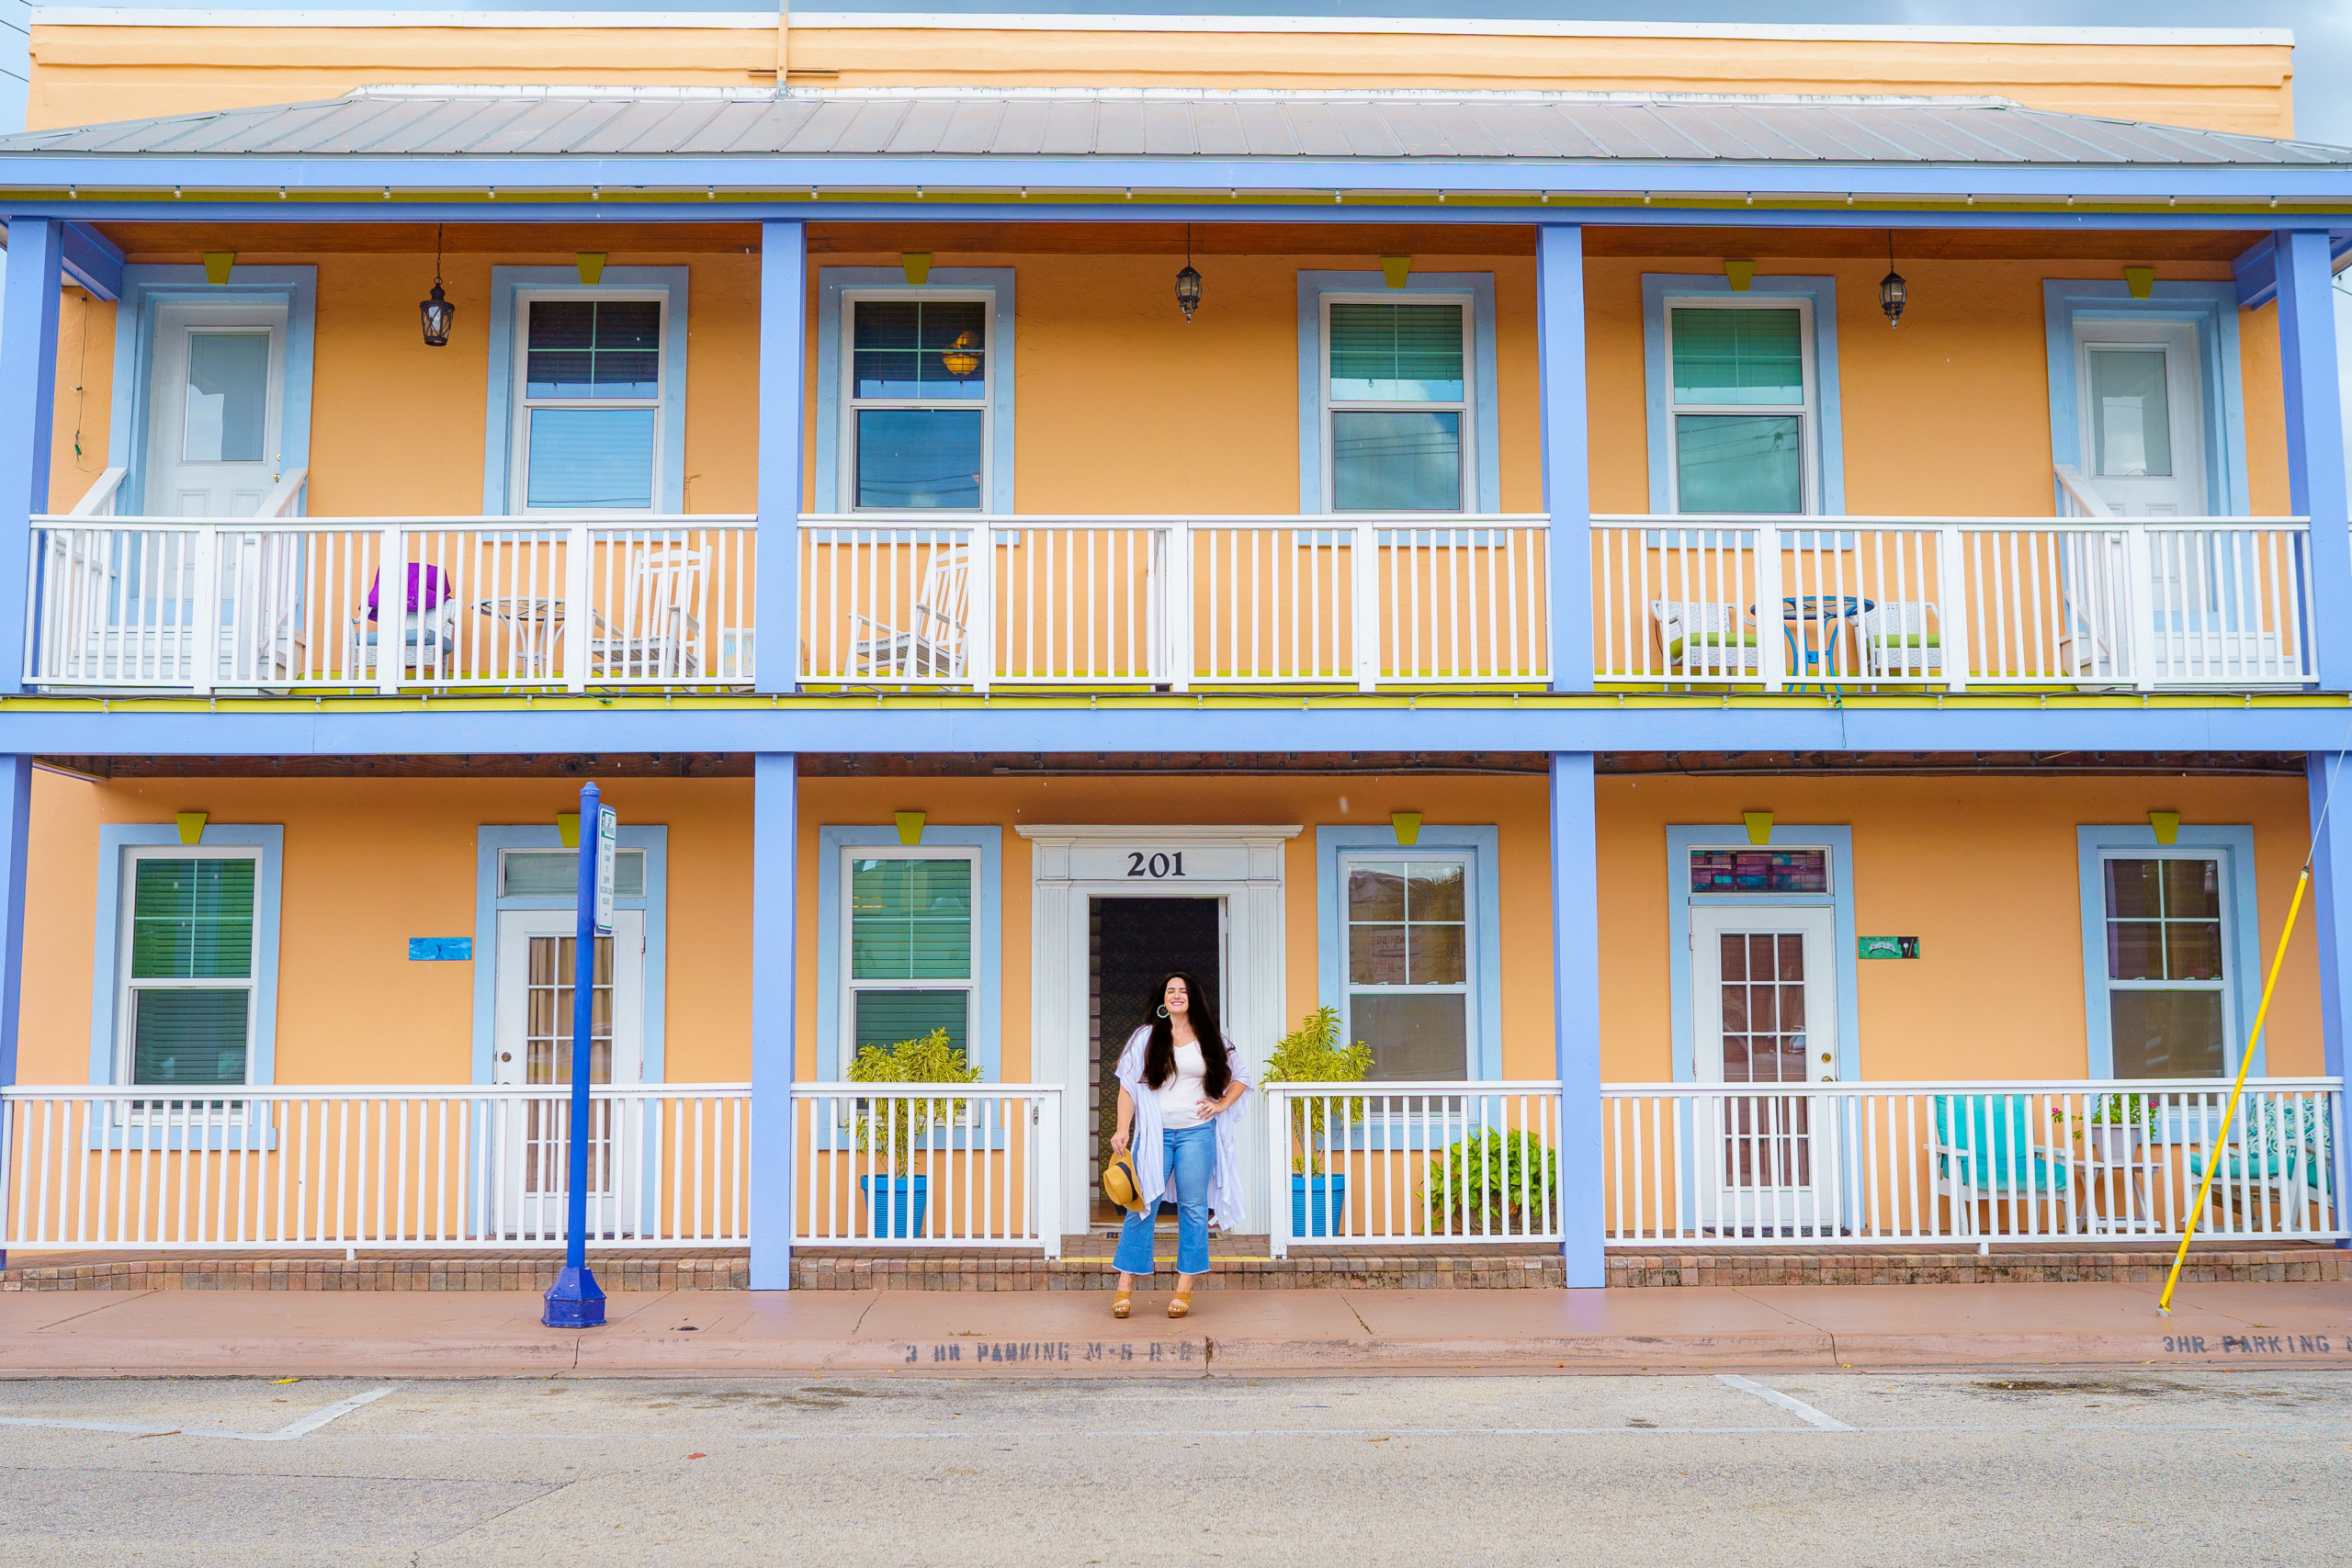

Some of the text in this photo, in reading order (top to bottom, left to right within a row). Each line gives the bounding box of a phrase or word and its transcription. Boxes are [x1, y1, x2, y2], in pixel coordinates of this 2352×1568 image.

[1127, 852, 1185, 878] 201
[906, 1345, 917, 1362] 3
[977, 1342, 1069, 1362] PARKING
[2163, 1336, 2207, 1353] 3HR
[2222, 1335, 2330, 1353] PARKING
